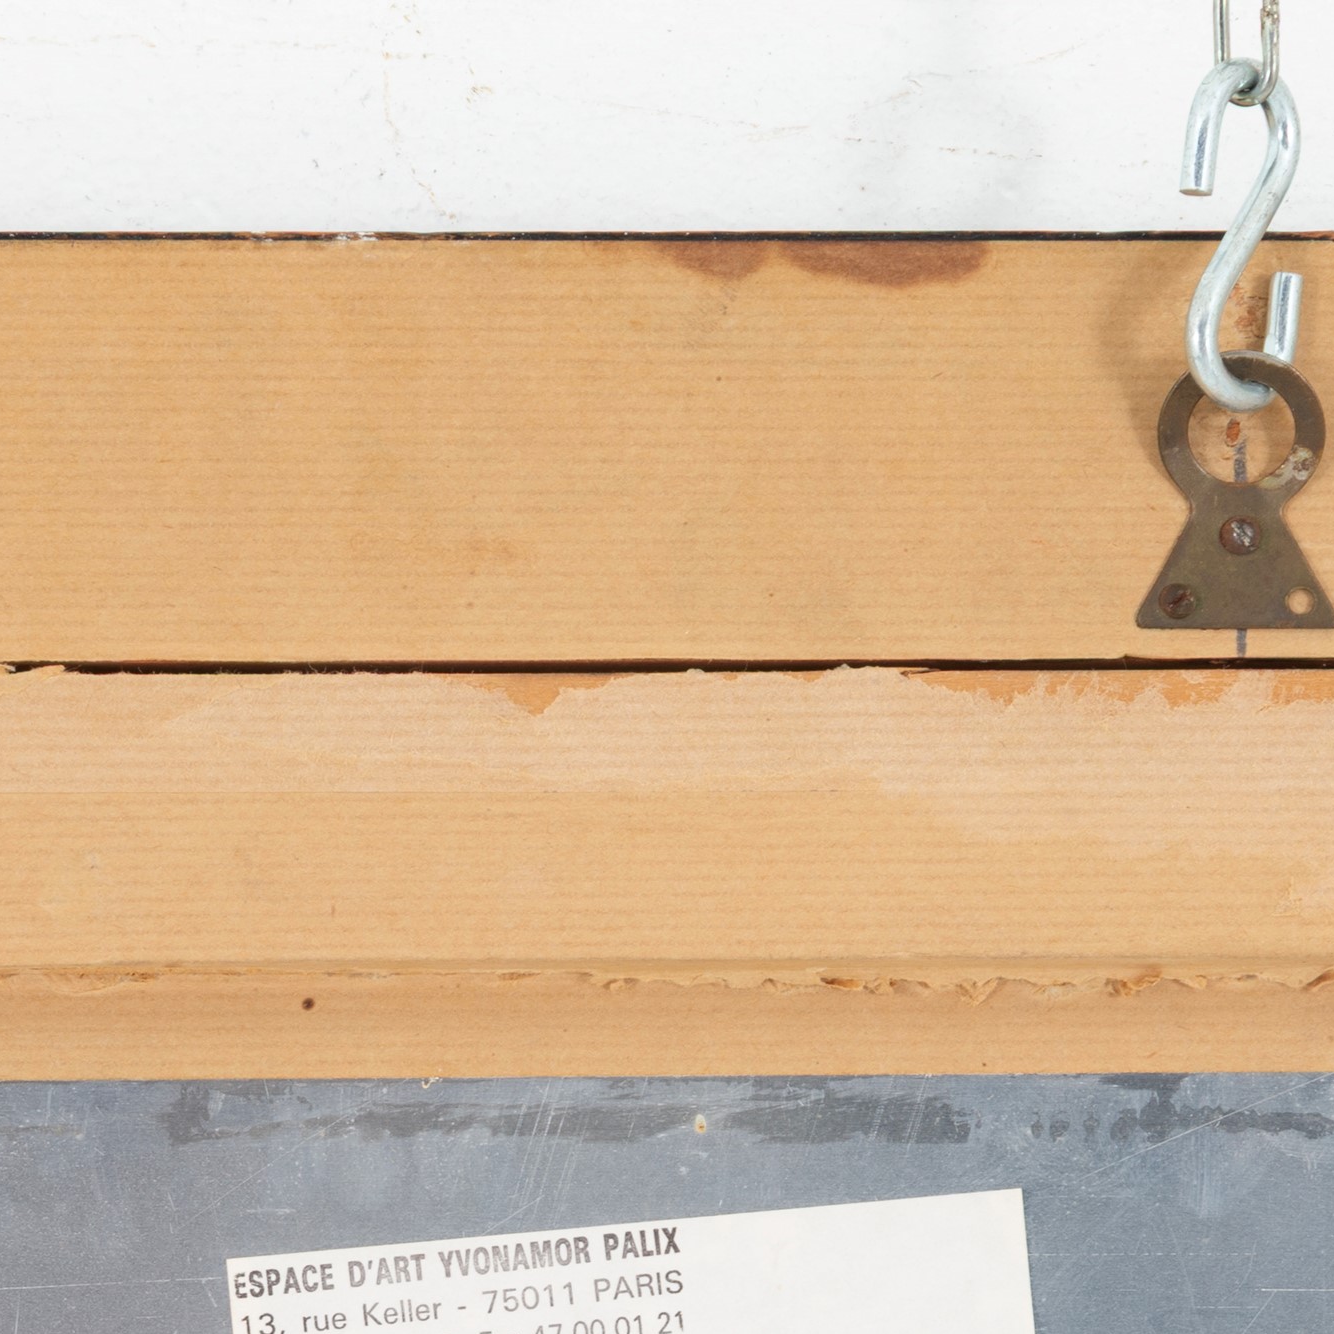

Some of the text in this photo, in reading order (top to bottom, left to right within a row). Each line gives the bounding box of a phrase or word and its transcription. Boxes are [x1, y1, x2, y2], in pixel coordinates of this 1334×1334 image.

[233, 1226, 681, 1299] ESPACE D'ART YVONAMOR PALIX
[302, 1312, 347, 1333] rue
[362, 1299, 442, 1327] Keller
[482, 1282, 574, 1314] 75011
[593, 1269, 684, 1303] PARIS
[657, 1310, 684, 1334] 21
